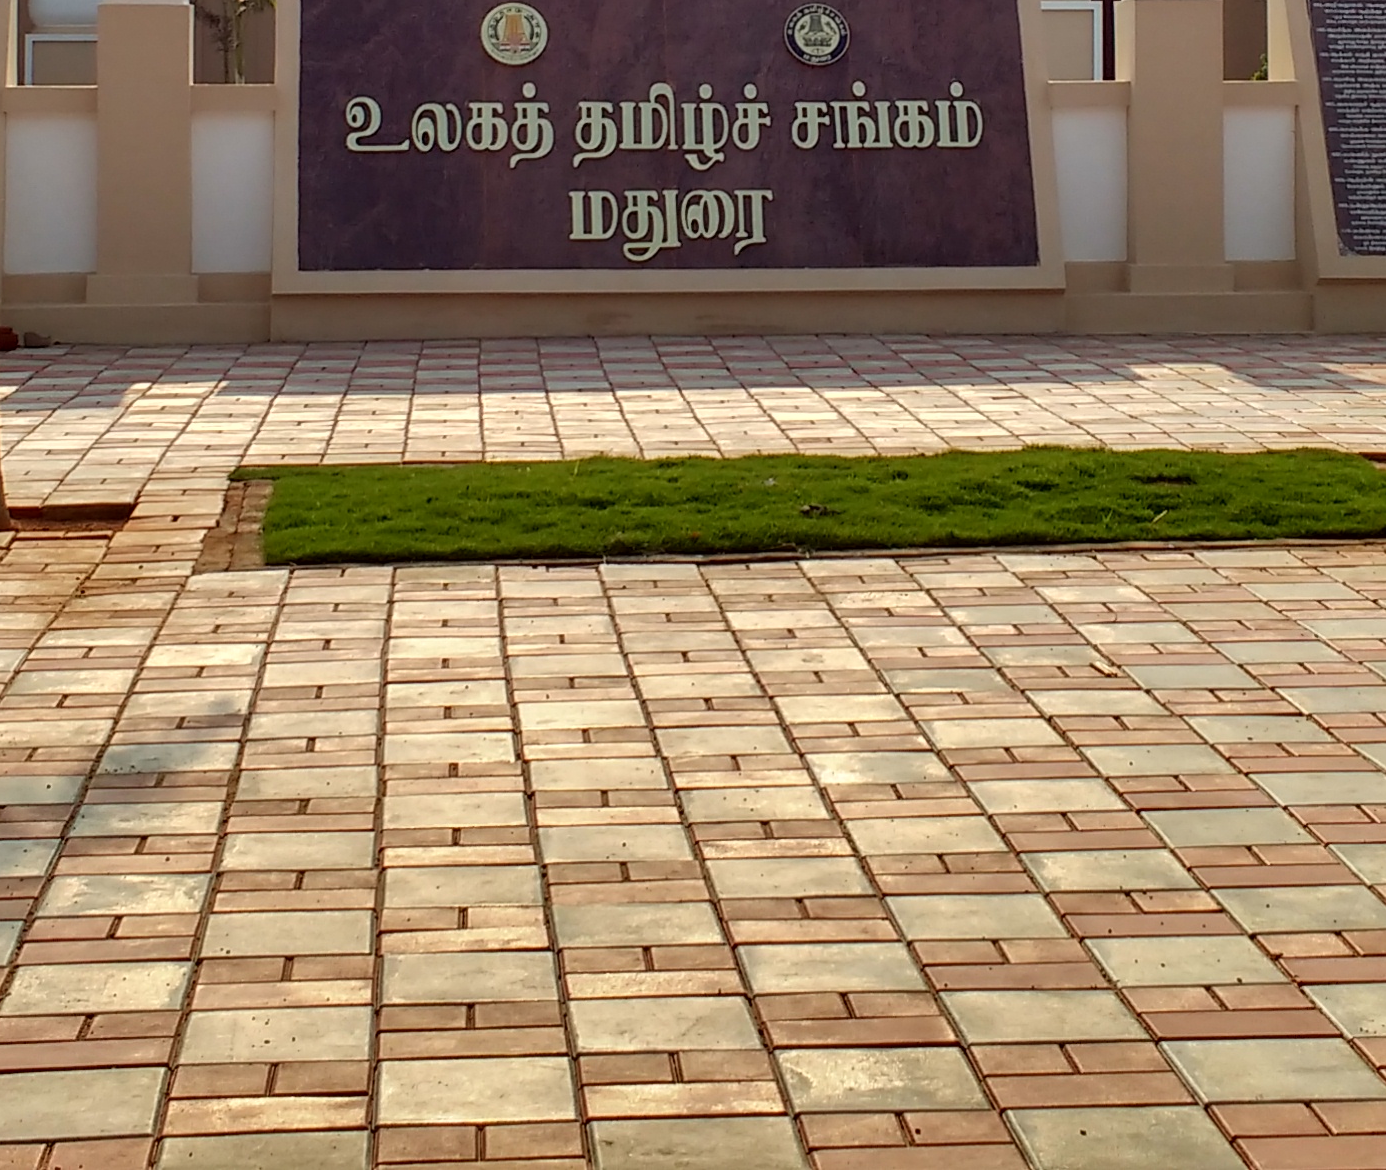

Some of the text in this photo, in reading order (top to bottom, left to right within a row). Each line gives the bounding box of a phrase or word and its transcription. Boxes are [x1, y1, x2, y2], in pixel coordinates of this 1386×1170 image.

[345, 81, 984, 171] உலகத் தமிழ்ச் சங்கம்
[568, 188, 773, 262] மதுரை
